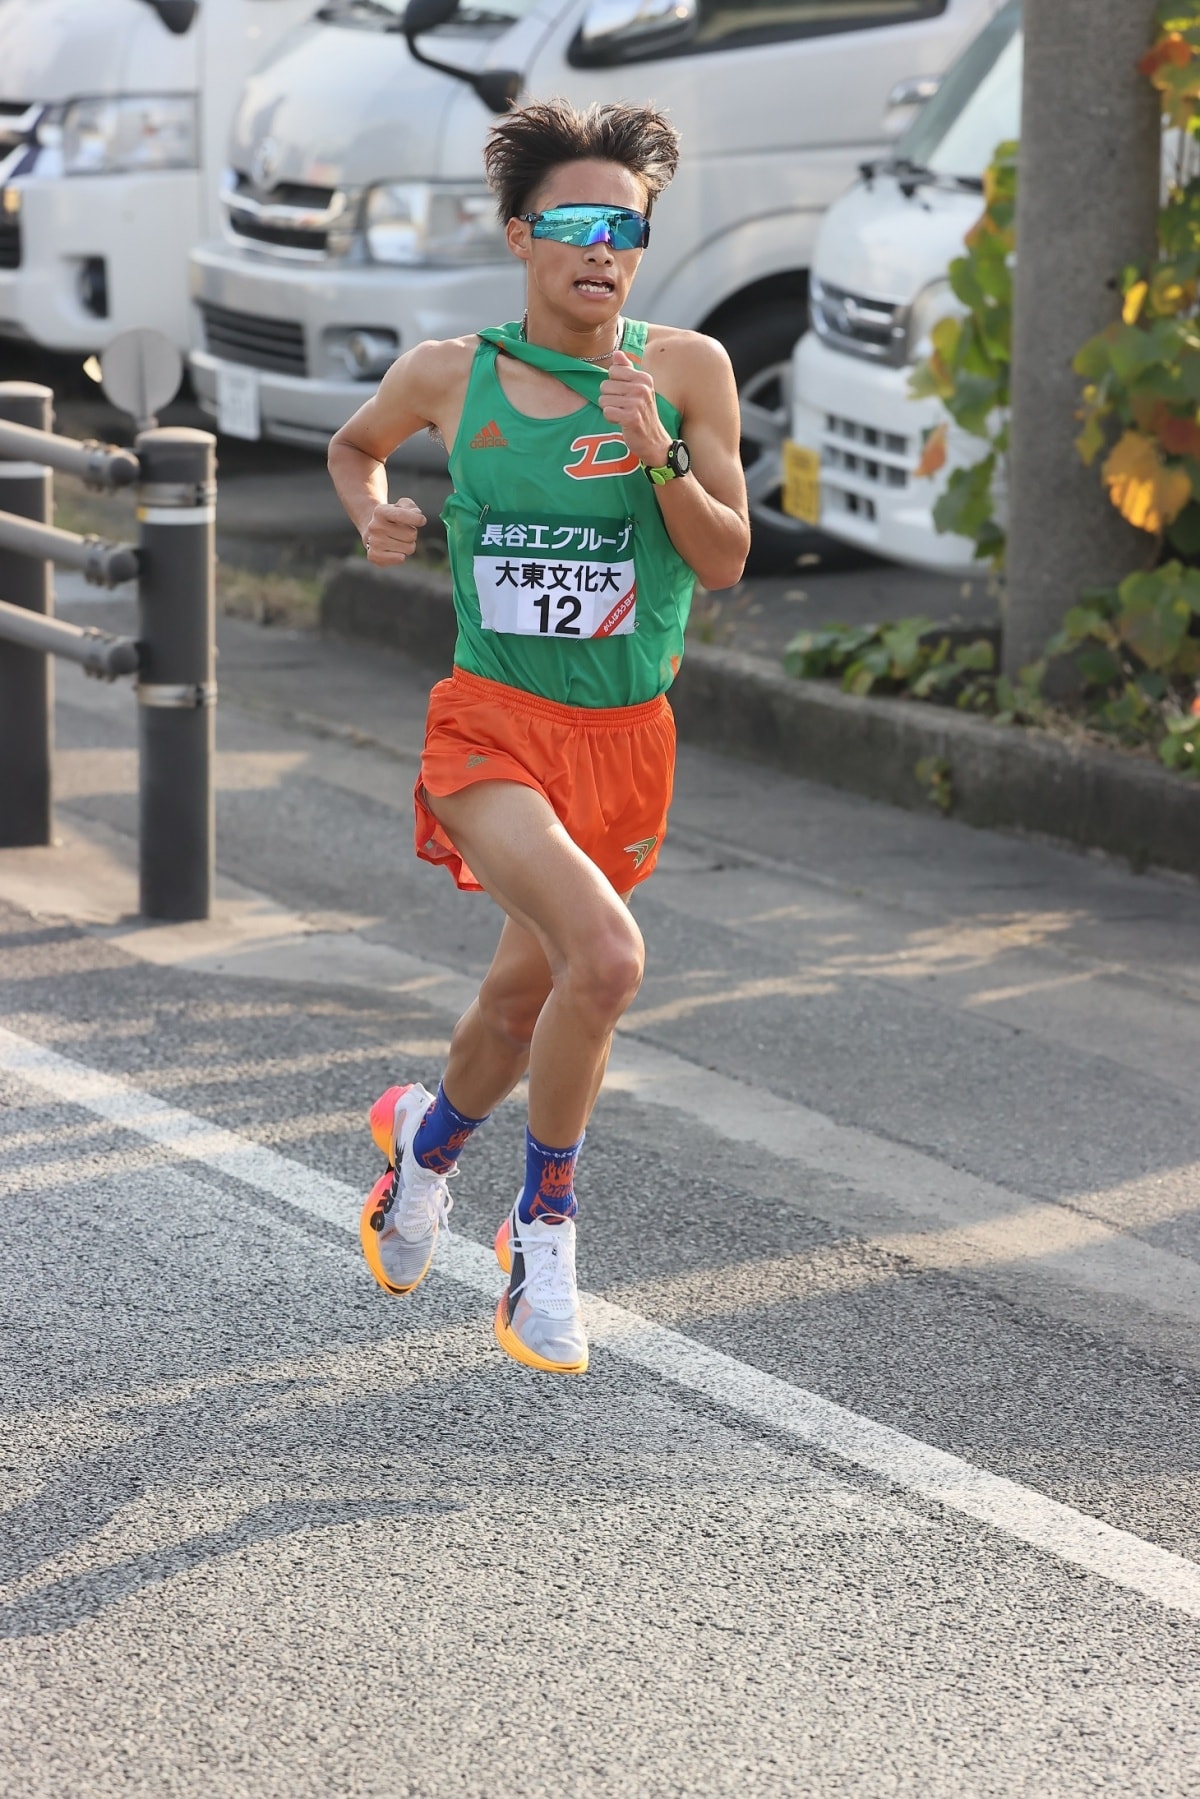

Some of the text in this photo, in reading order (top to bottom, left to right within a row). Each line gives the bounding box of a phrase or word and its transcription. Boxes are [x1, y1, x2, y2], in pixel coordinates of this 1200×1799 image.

[469, 436, 508, 449] adidas
[563, 432, 641, 480] D
[481, 523, 632, 553] 長谷工グループ
[495, 560, 621, 593] 大東文化大
[533, 594, 582, 635] 12
